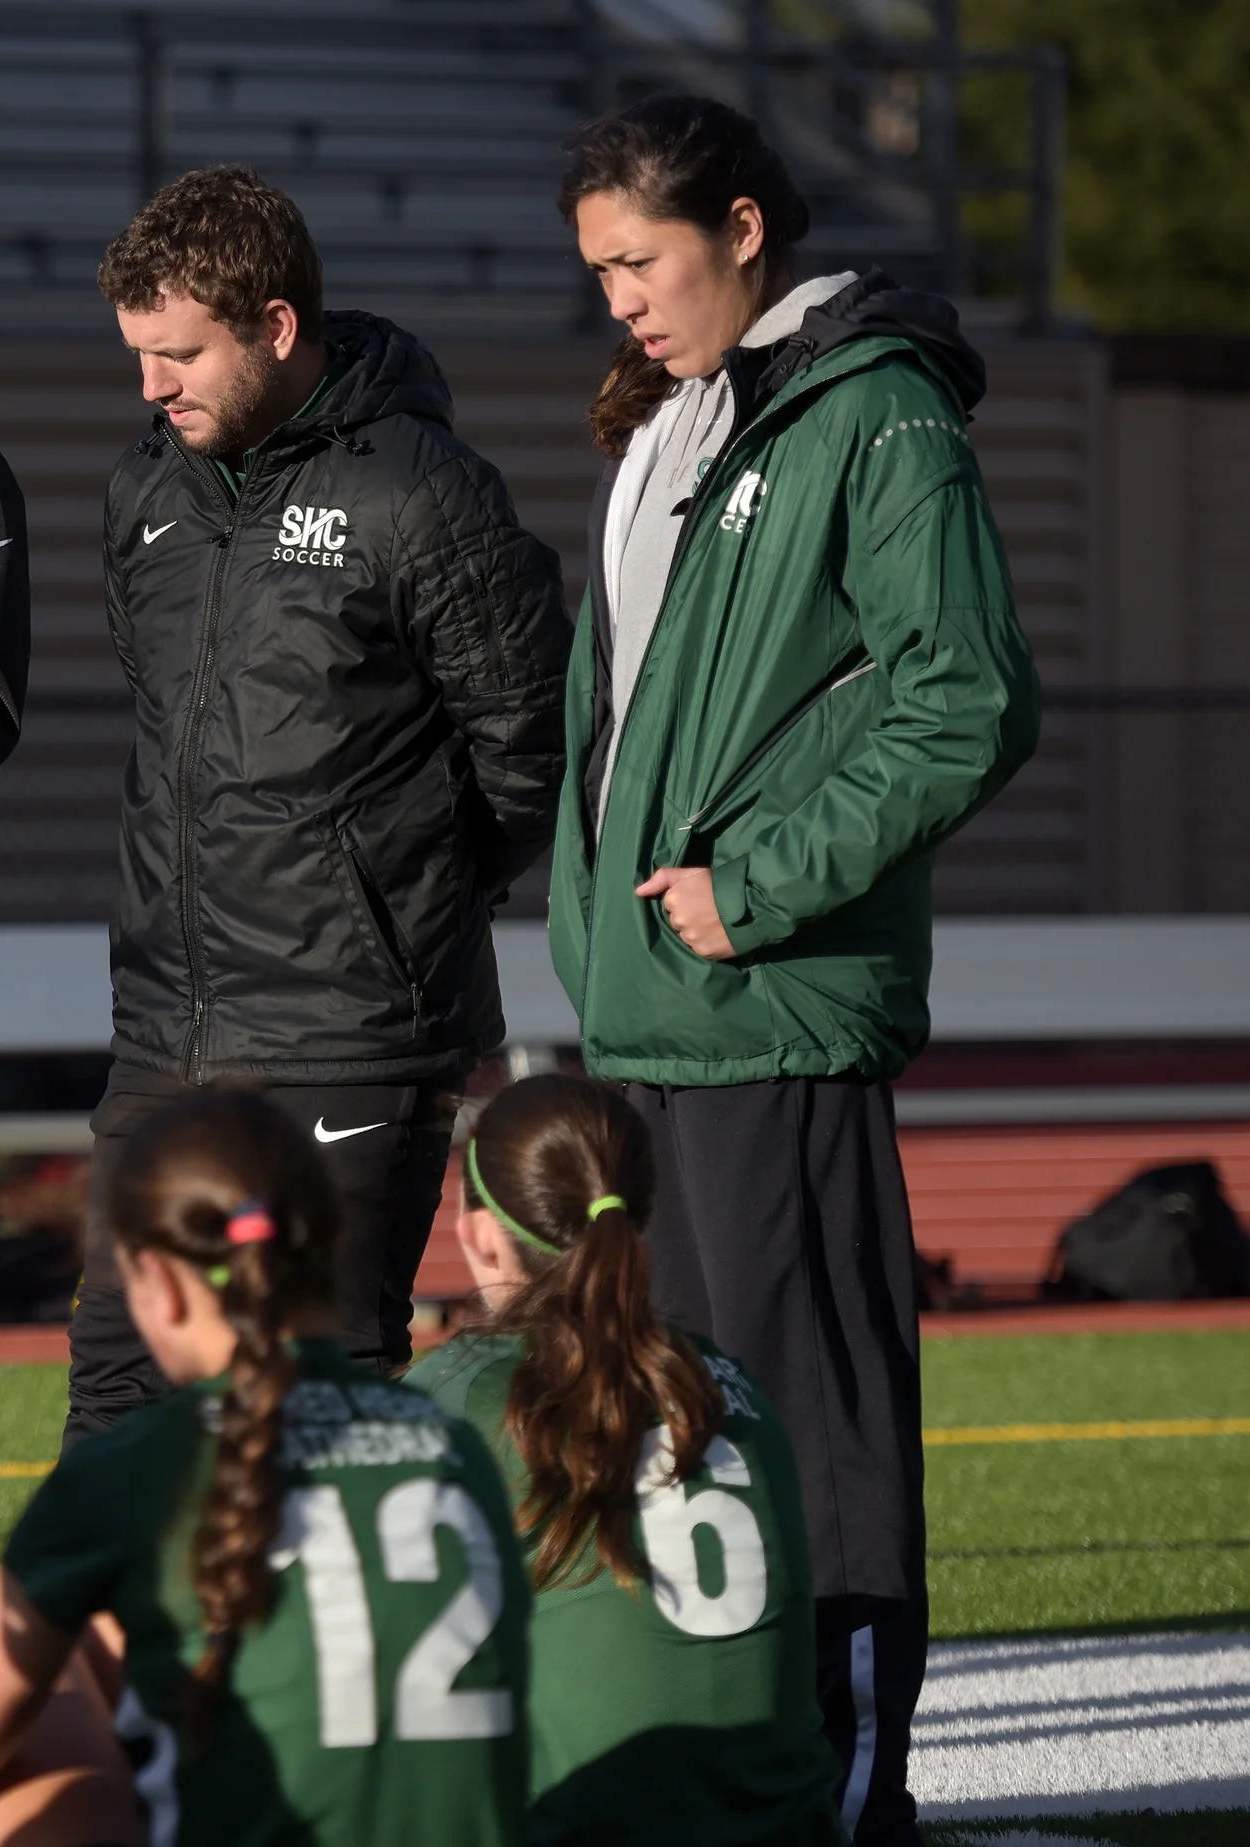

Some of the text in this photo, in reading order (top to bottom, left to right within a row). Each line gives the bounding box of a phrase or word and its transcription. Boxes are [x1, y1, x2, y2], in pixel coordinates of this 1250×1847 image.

[272, 546, 344, 568] SOCCER
[279, 504, 348, 551] SHC
[636, 1424, 766, 1636] 6
[268, 1478, 514, 1748] 12
